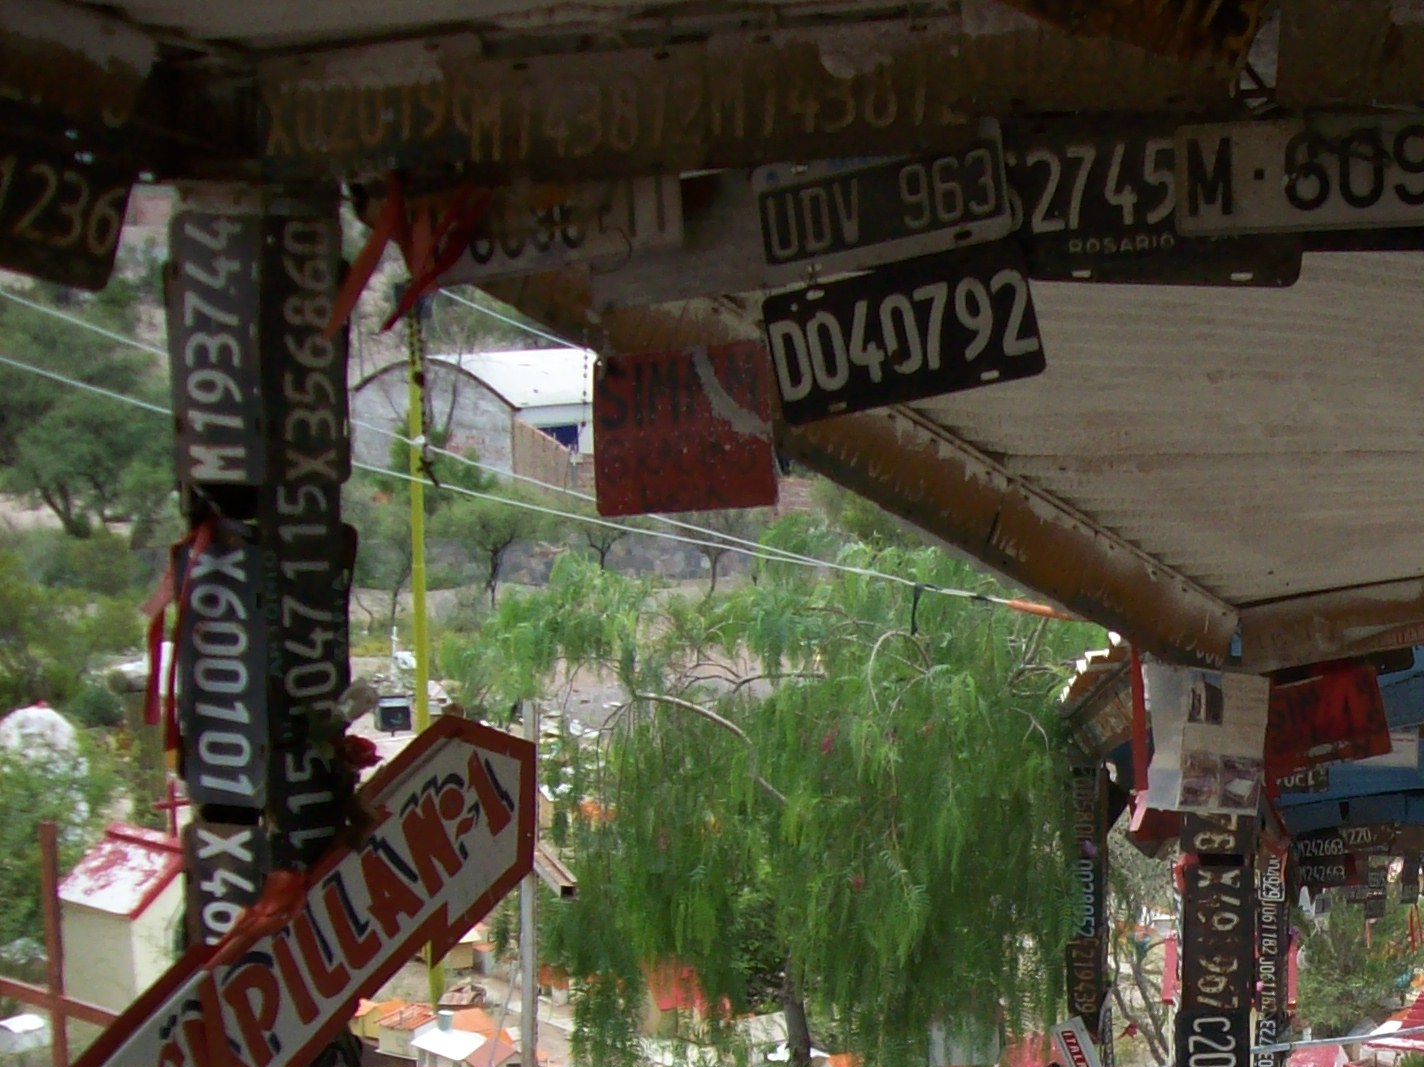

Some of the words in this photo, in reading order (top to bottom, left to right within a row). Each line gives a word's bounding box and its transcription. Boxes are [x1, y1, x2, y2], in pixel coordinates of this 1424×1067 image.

[765, 177, 860, 260] UDV
[897, 146, 997, 230] 963
[1068, 234, 1176, 254] ROSARIO
[184, 215, 244, 484] M193744
[283, 220, 337, 477] X356860
[767, 267, 1041, 402] D040792
[190, 548, 257, 798] X600101
